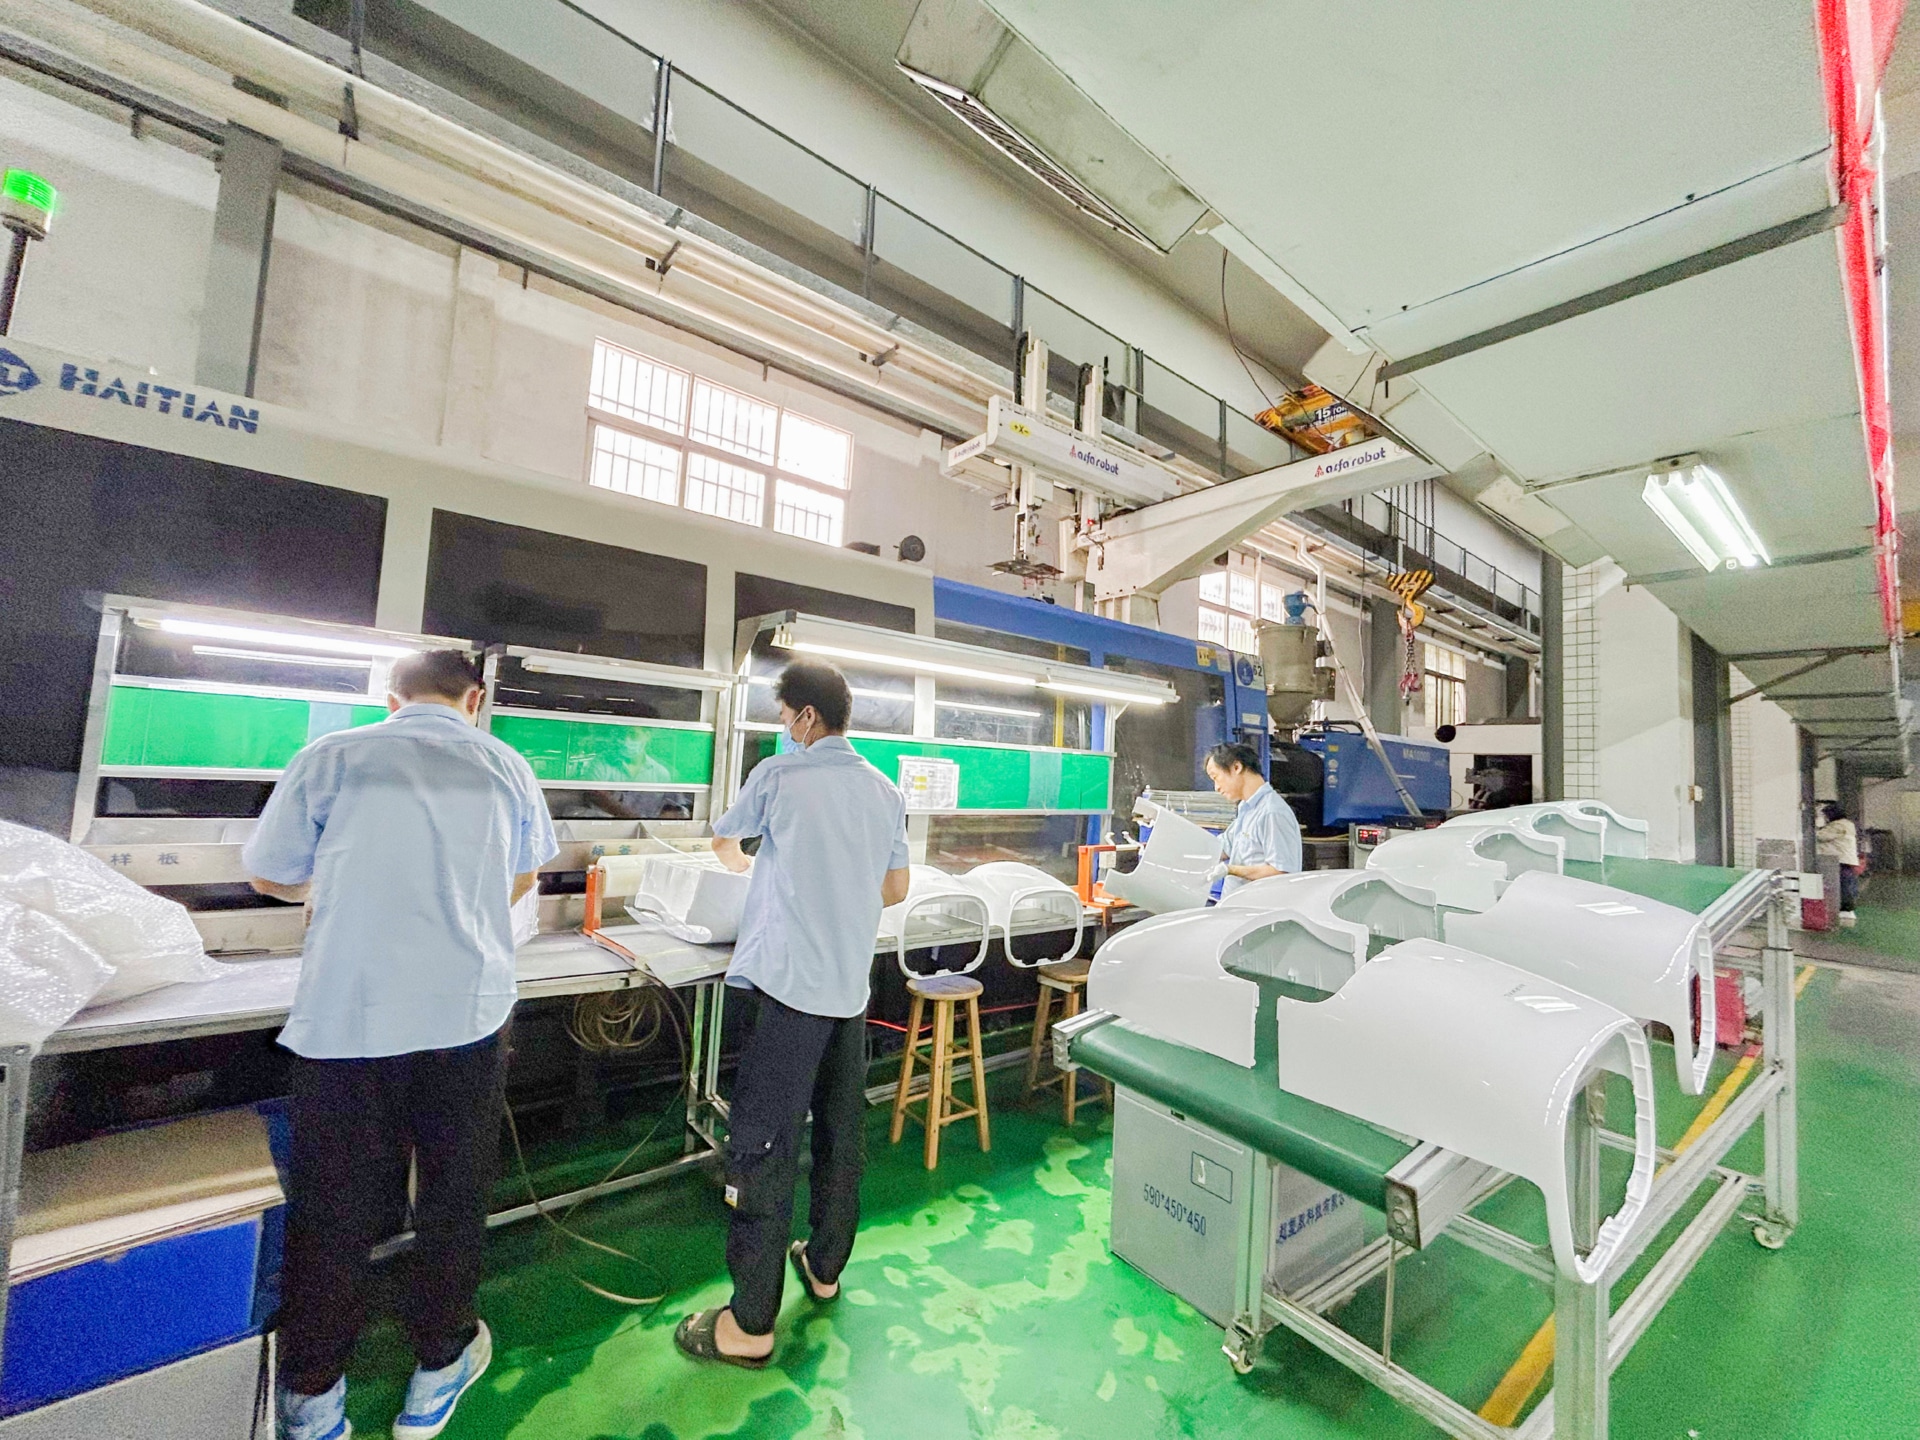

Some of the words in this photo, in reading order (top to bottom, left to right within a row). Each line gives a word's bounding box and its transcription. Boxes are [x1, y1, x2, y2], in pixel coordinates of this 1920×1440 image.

[59, 363, 259, 434] HAITIAN
[1315, 407, 1331, 420] 15
[1351, 447, 1386, 467] robot
[1096, 458, 1119, 475] robot
[110, 852, 180, 866] 样板
